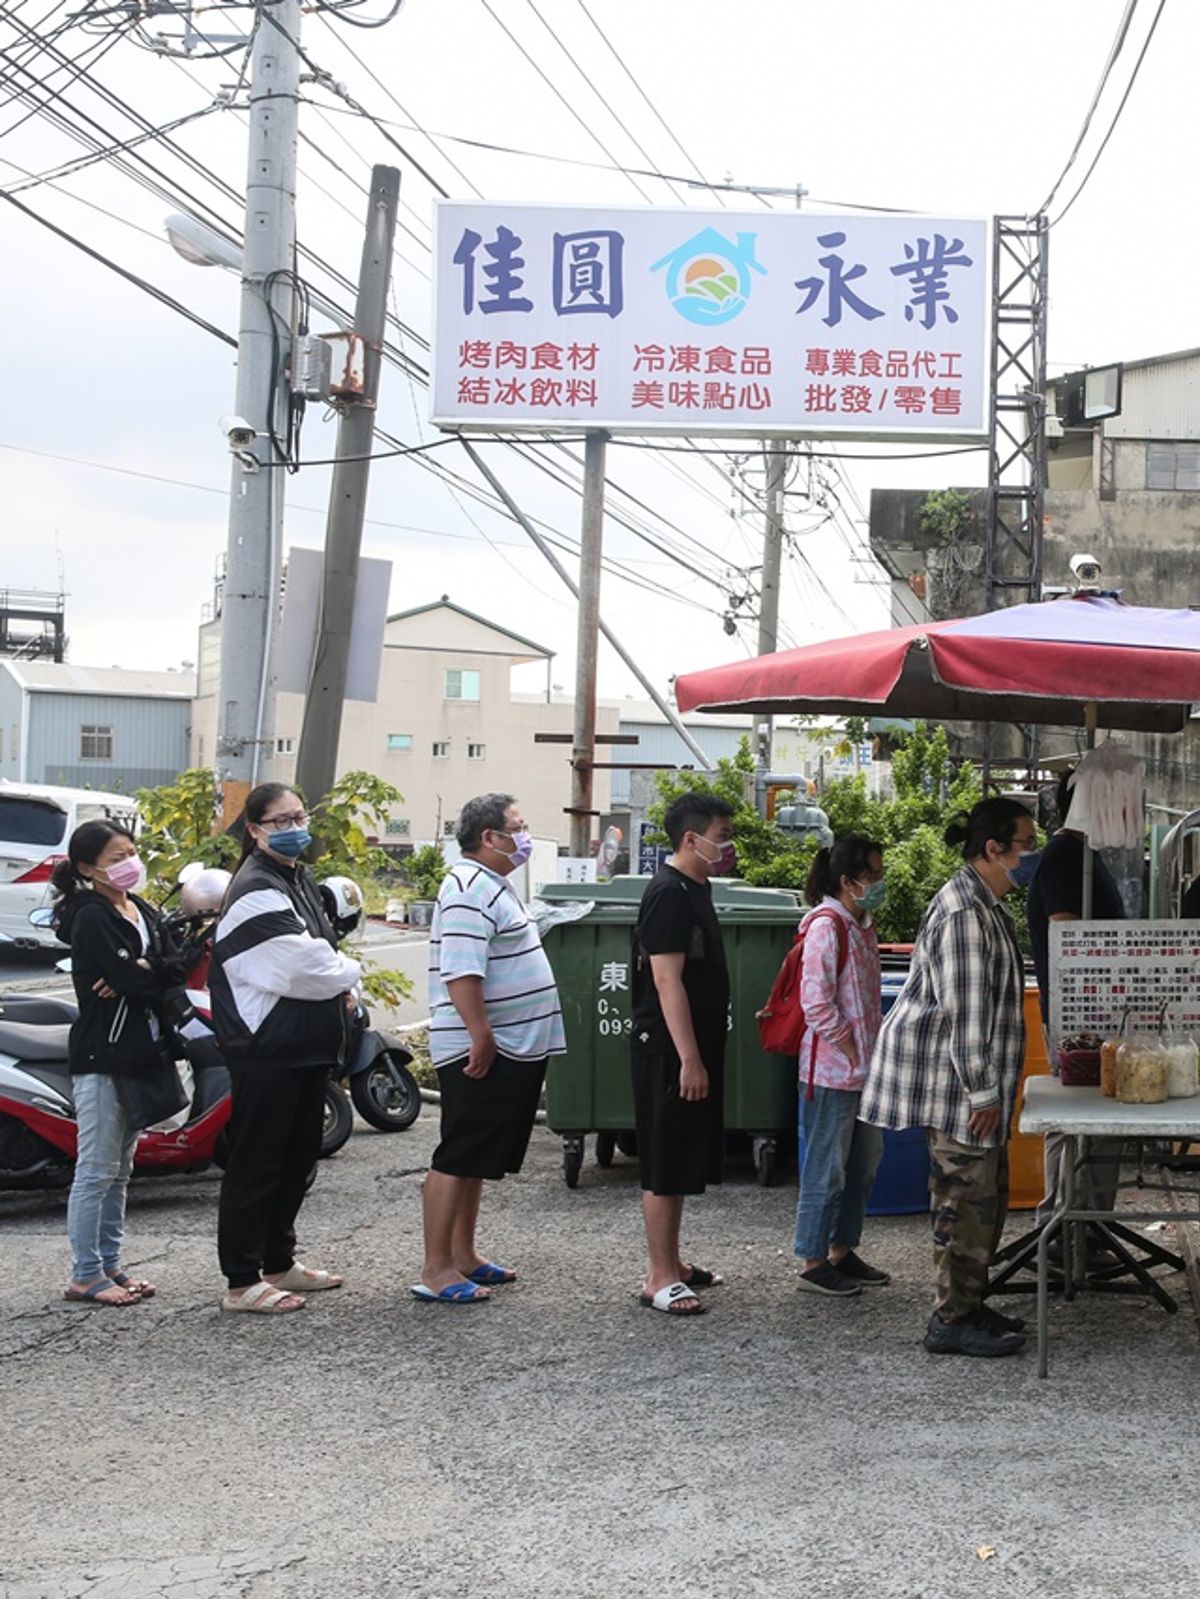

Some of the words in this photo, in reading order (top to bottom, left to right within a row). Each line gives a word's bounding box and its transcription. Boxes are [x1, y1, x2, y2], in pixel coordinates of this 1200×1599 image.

[453, 225, 625, 320] 佳圓
[795, 231, 974, 330] 永業
[458, 341, 600, 373] 烤肉食材
[633, 344, 772, 376] 冷凍食品
[805, 348, 963, 379] 專業食品代工
[457, 376, 598, 408] 結冰飲料
[631, 379, 772, 411] 美味點心
[804, 383, 963, 416] 批發/零售
